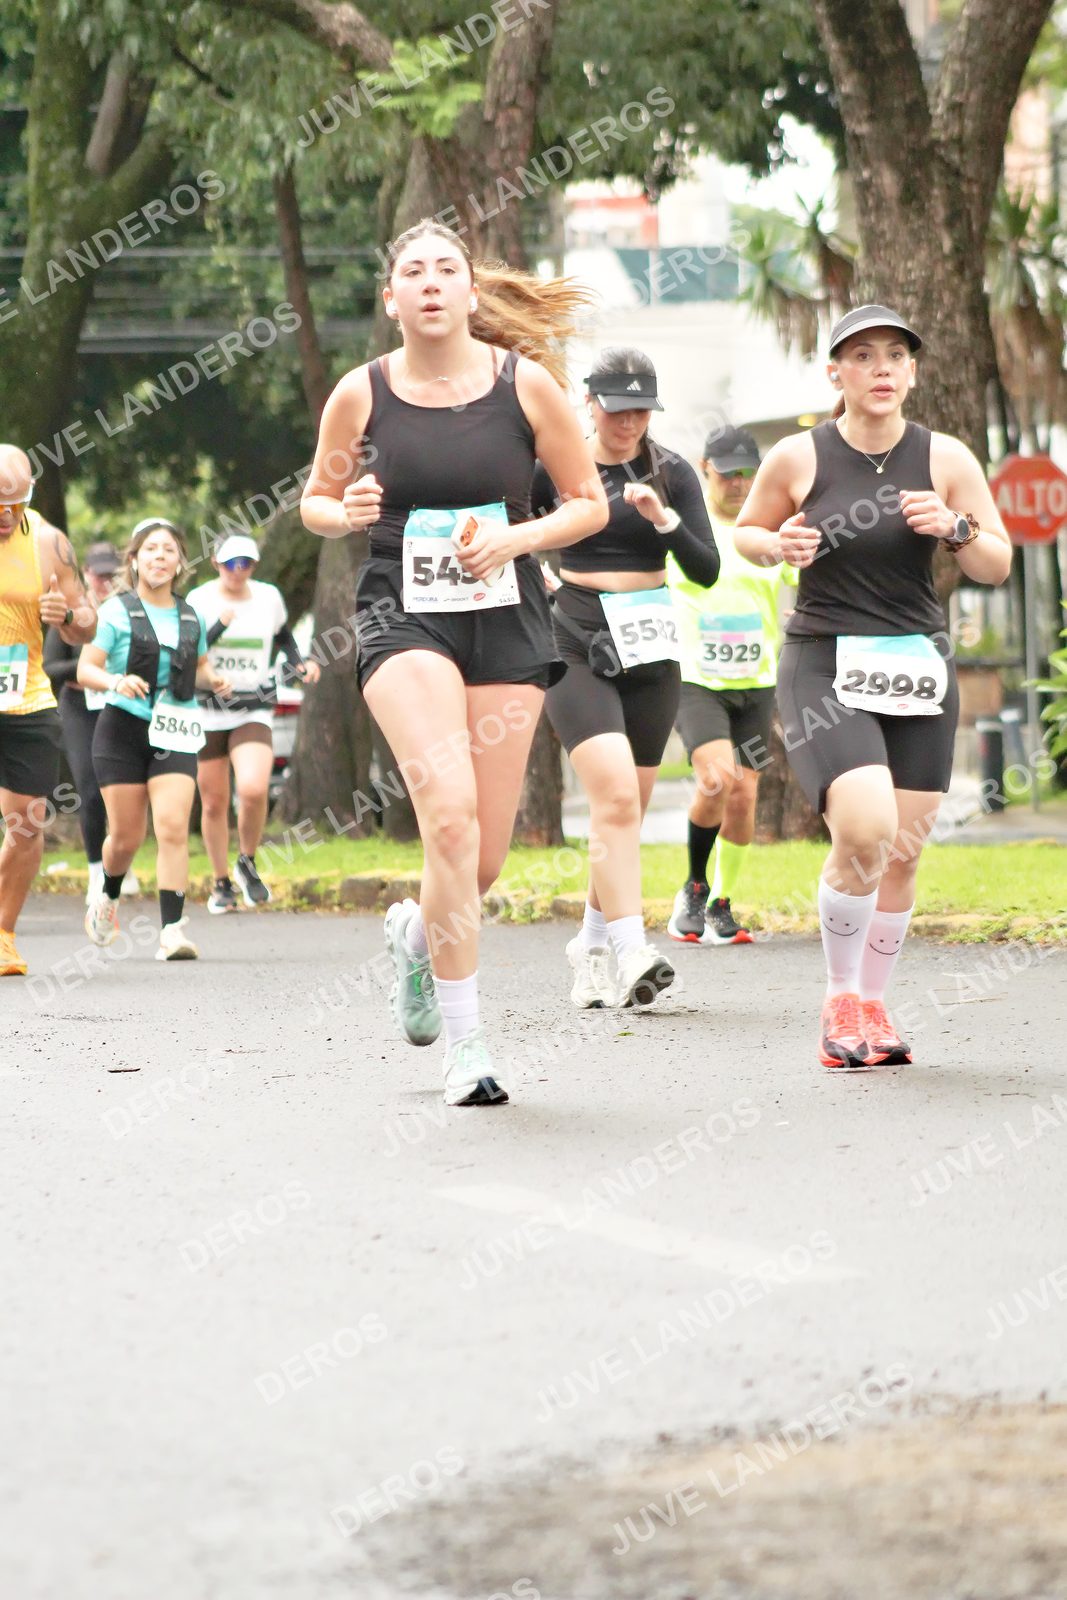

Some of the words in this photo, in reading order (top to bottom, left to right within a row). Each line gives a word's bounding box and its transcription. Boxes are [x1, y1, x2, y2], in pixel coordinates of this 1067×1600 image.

[994, 478, 1067, 517] ALTO
[215, 655, 258, 672] 2054
[703, 642, 761, 663] 3929
[841, 669, 937, 700] 2998
[154, 714, 202, 738] 5840
